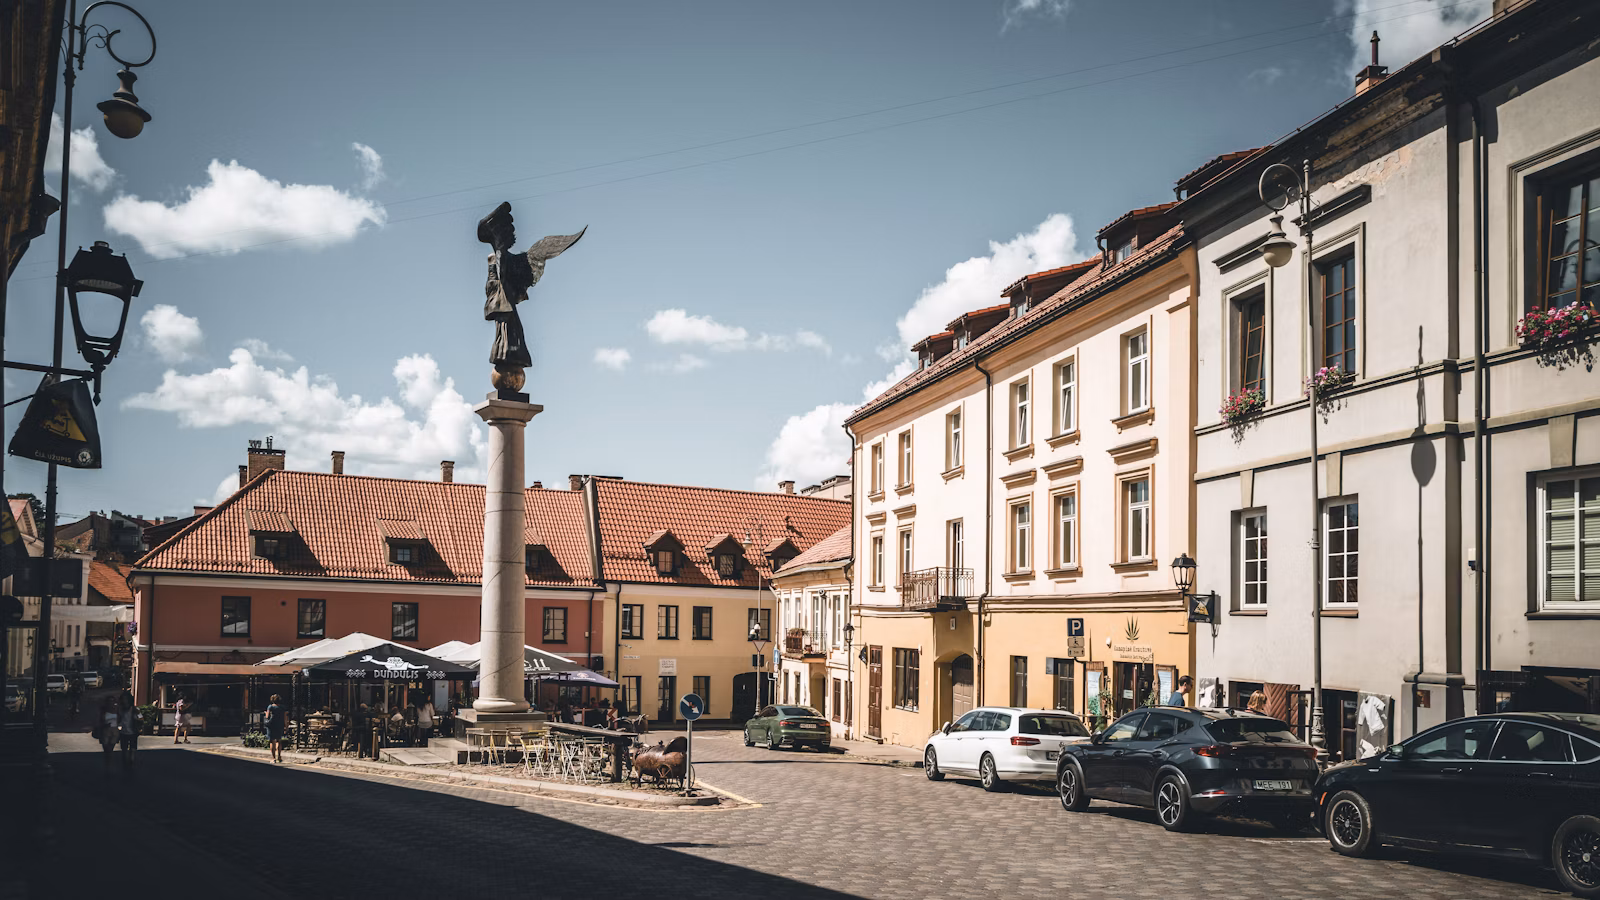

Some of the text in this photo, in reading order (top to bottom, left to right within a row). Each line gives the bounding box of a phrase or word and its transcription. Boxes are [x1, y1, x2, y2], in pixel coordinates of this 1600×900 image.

[1071, 619, 1082, 635] P
[373, 669, 419, 679] DUNDULIS
[1256, 780, 1291, 789] MEE 191
